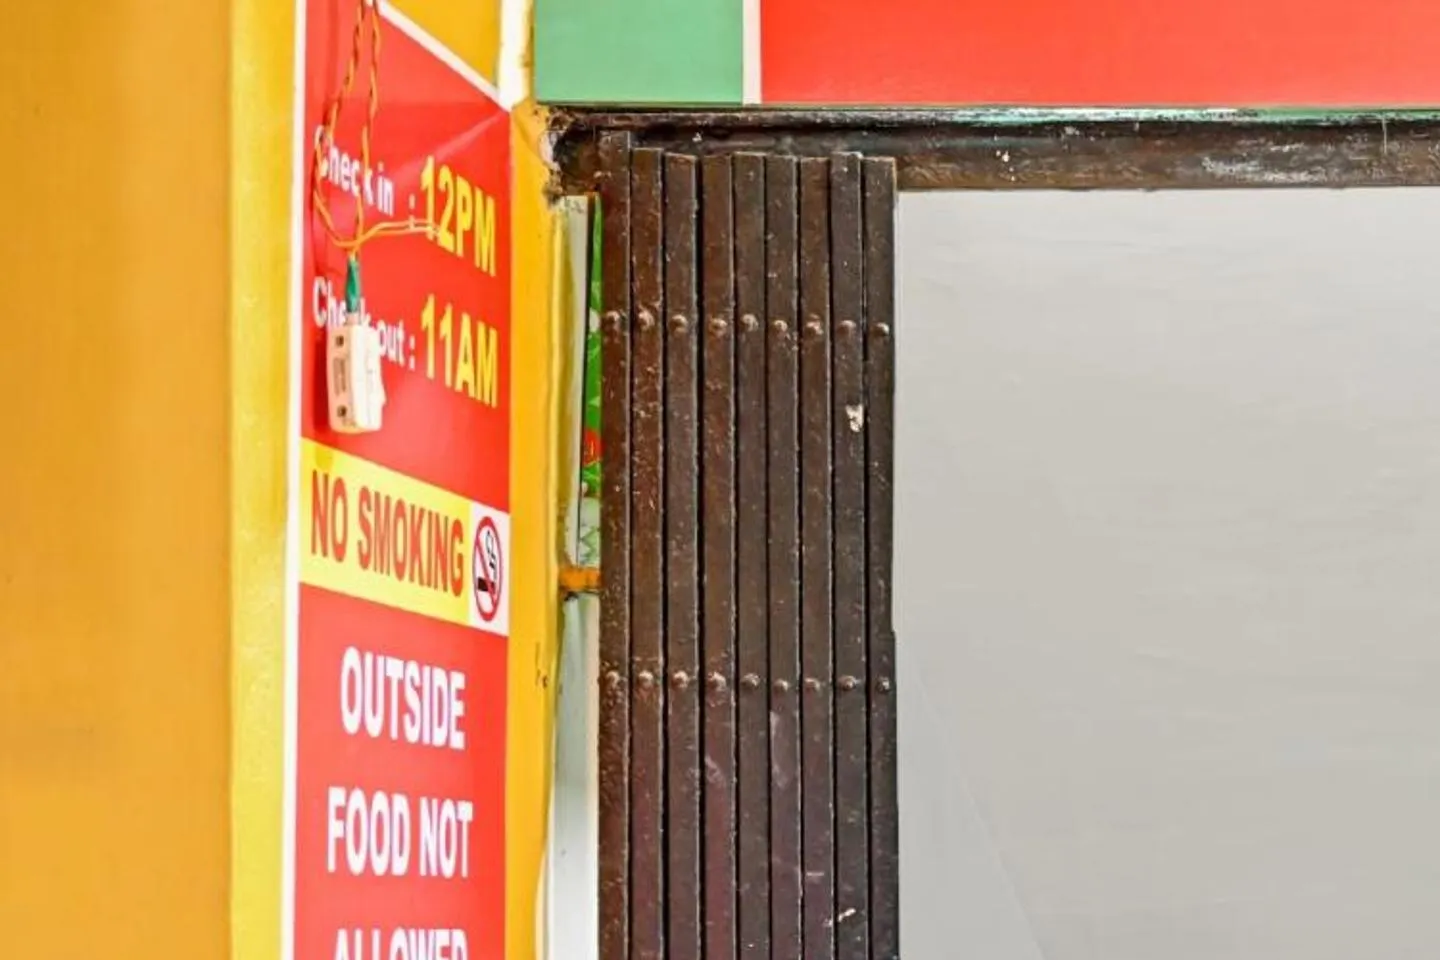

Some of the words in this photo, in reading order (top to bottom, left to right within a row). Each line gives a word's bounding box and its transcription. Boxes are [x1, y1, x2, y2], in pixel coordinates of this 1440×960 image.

[420, 155, 497, 277] 12PM
[421, 294, 498, 408] 11AM
[311, 469, 348, 563] NO
[357, 486, 464, 598] SMOKING
[340, 645, 466, 750] OUTSIDE
[326, 785, 412, 877] FOOD
[419, 797, 474, 879] NOT
